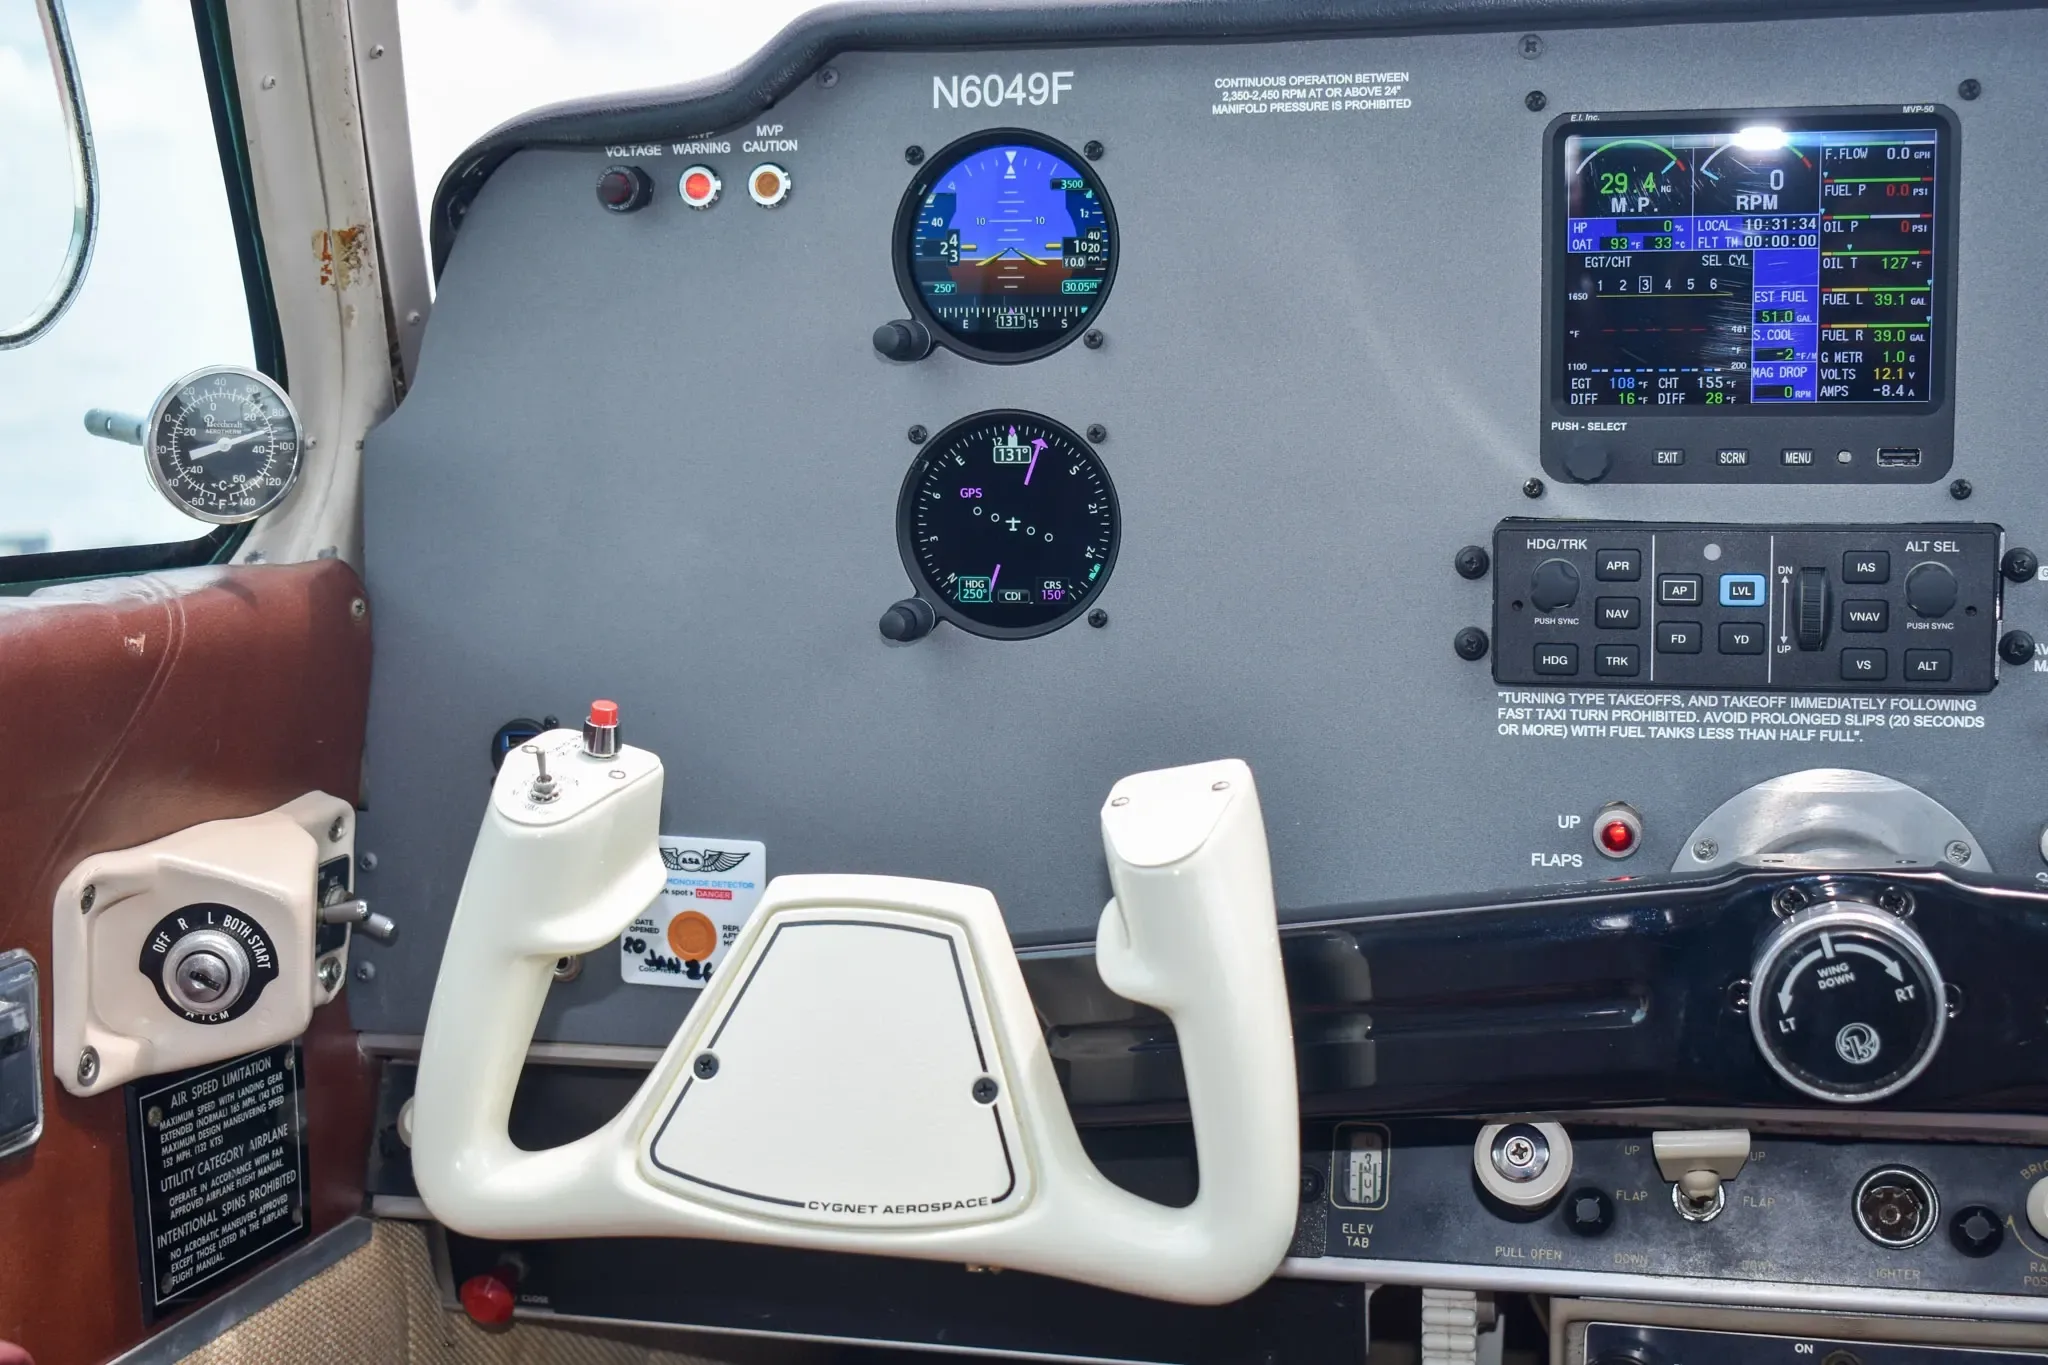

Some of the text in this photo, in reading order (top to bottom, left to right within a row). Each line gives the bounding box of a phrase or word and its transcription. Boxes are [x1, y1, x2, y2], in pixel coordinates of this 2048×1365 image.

[1215, 72, 1409, 89] CONTINUOUS OPERATION BETWEEN
[933, 72, 1074, 108] N6049F
[1222, 85, 1401, 102] 2,350-2,450 RPM AT OR ABOVE 24"
[1212, 99, 1411, 115] MANIFOLD PRESSURE IS PROHIBITED
[1902, 105, 1934, 113] MVP-50
[756, 125, 783, 136] MVP
[605, 145, 662, 157] VOLTAGE
[672, 142, 731, 155] WARNING
[743, 140, 798, 153] CAUTION
[1825, 147, 1910, 160] F.FLOW 0.0
[1060, 179, 1084, 189] 3500
[1600, 172, 1655, 194] 29.4
[1824, 185, 1852, 196] FUEL
[1611, 198, 1658, 213] M.P.
[1736, 195, 1778, 211] RPM
[1698, 218, 1816, 231] LOCAL 10:31:34
[1823, 221, 1844, 232] OIL
[1698, 235, 1816, 248] FLT TM 00:00:00
[1585, 256, 1632, 268] EGT/CHT
[1702, 254, 1748, 266] SEL CYL
[1823, 257, 1908, 269] OIL 127
[1754, 291, 1808, 303] EST FUEL
[1822, 293, 1904, 306] FUEL 39.1
[1761, 310, 1793, 322] 51.0
[1822, 330, 1905, 342] FUEL 39.0
[1752, 367, 1808, 378] MAG DROP
[1820, 368, 1904, 380] VOLTS 12.1
[1571, 377, 1723, 389] EGT 108 CHT 155
[1820, 385, 1904, 397] AMPS -8.4
[1571, 393, 1723, 405] DIFF 16 DIFF 28
[1552, 422, 1627, 431] PUSH SELECT
[279, 442, 294, 450] 100
[1658, 452, 1678, 464] EXIT
[1720, 452, 1745, 464] SCRN
[1785, 452, 1811, 464] MENU
[266, 478, 281, 486] 120
[960, 488, 983, 498] GPS
[1526, 539, 1587, 550] HDG/TRK
[1905, 541, 1960, 552] ALT SEL
[1606, 562, 1630, 571] APR
[1778, 566, 1793, 574] DN
[1857, 563, 1876, 572] IAS
[965, 580, 984, 589] HDG
[1044, 581, 1061, 589] CRS
[1672, 586, 1688, 595] AP
[1004, 592, 1021, 601] CDI
[1732, 587, 1751, 595] LVL
[1606, 610, 1629, 618] NAV
[1850, 612, 1880, 622] VNAV
[1906, 622, 1954, 630] PUSH SYNC
[1671, 635, 1686, 644] FD
[1734, 635, 1749, 644] YD
[1777, 645, 1791, 654] UP
[1542, 656, 1568, 665] HDG
[1606, 657, 1628, 666] TRK
[1856, 661, 1872, 670] VS
[1917, 662, 1938, 671] ALT
[1498, 692, 1976, 712] "TURNING TYPE TAKEOFFS, AND TAKEOFF IMMEDIATELY FOLLOWING
[1498, 708, 1984, 728] FAST TAXI TURN PROHIBITED. AVOID PROLONGED SLIPS (20 SECONDS
[1498, 724, 1816, 741] OR MORE) WITH FUEL TANKS LESS THAN HALF
[1558, 816, 1580, 828] UP
[1531, 853, 1582, 867] FLAPS
[667, 878, 755, 889] MONOXIDE DETECTOR
[696, 890, 731, 899] DANGER
[178, 918, 188, 930] R
[223, 914, 251, 939] BOTH
[630, 926, 659, 934] OPENED
[153, 932, 172, 953] OFF
[248, 934, 271, 969] START
[1817, 962, 1849, 978] WING
[1818, 972, 1855, 989] DOWN
[1895, 985, 1915, 1002] RT
[1779, 1018, 1796, 1033] LT
[171, 1056, 271, 1109] AIR SPEED LIMITATION
[1624, 1146, 1640, 1155] UP
[160, 1123, 289, 1191] UTILITY CATEGORY AIRPLANE
[1616, 1190, 1648, 1201] FLAP
[1743, 1196, 1775, 1207] FLAP
[157, 1169, 297, 1249] INTENTIONAL SPINS PROHIBITED
[808, 1196, 988, 1214] CYGNET AEROSPACE
[1342, 1223, 1374, 1234] ELEV
[1346, 1236, 1369, 1248] TAB
[1495, 1247, 1562, 1260] PULL OPEN
[1794, 1343, 1813, 1354] ON
